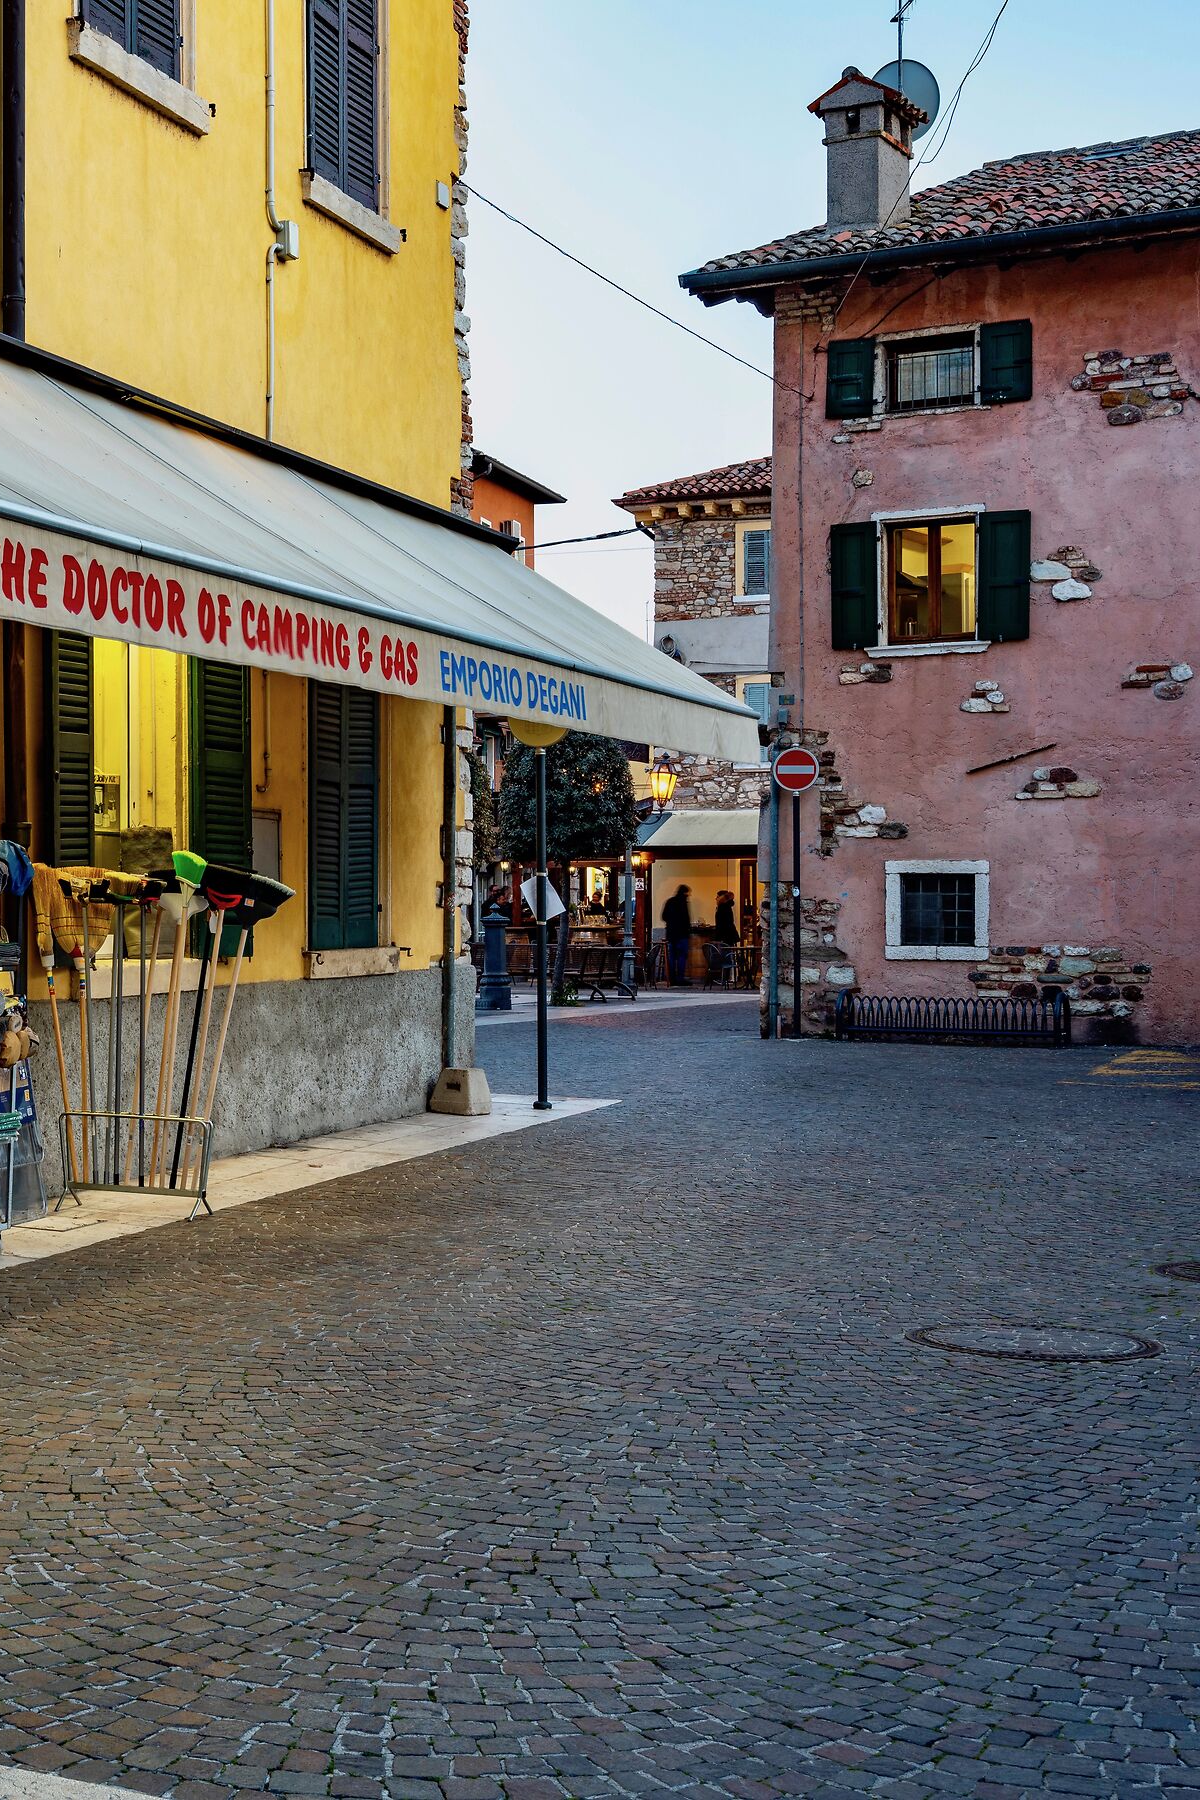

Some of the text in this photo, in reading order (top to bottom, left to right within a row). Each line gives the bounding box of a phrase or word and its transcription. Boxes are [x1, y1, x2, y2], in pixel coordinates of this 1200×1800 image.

[63, 555, 188, 638] DOCTOR
[198, 588, 233, 646] OF
[241, 600, 351, 671] CAMPING
[357, 627, 373, 673] &
[380, 635, 420, 686] GAS
[440, 651, 587, 721] EMPORIO DEGANI
